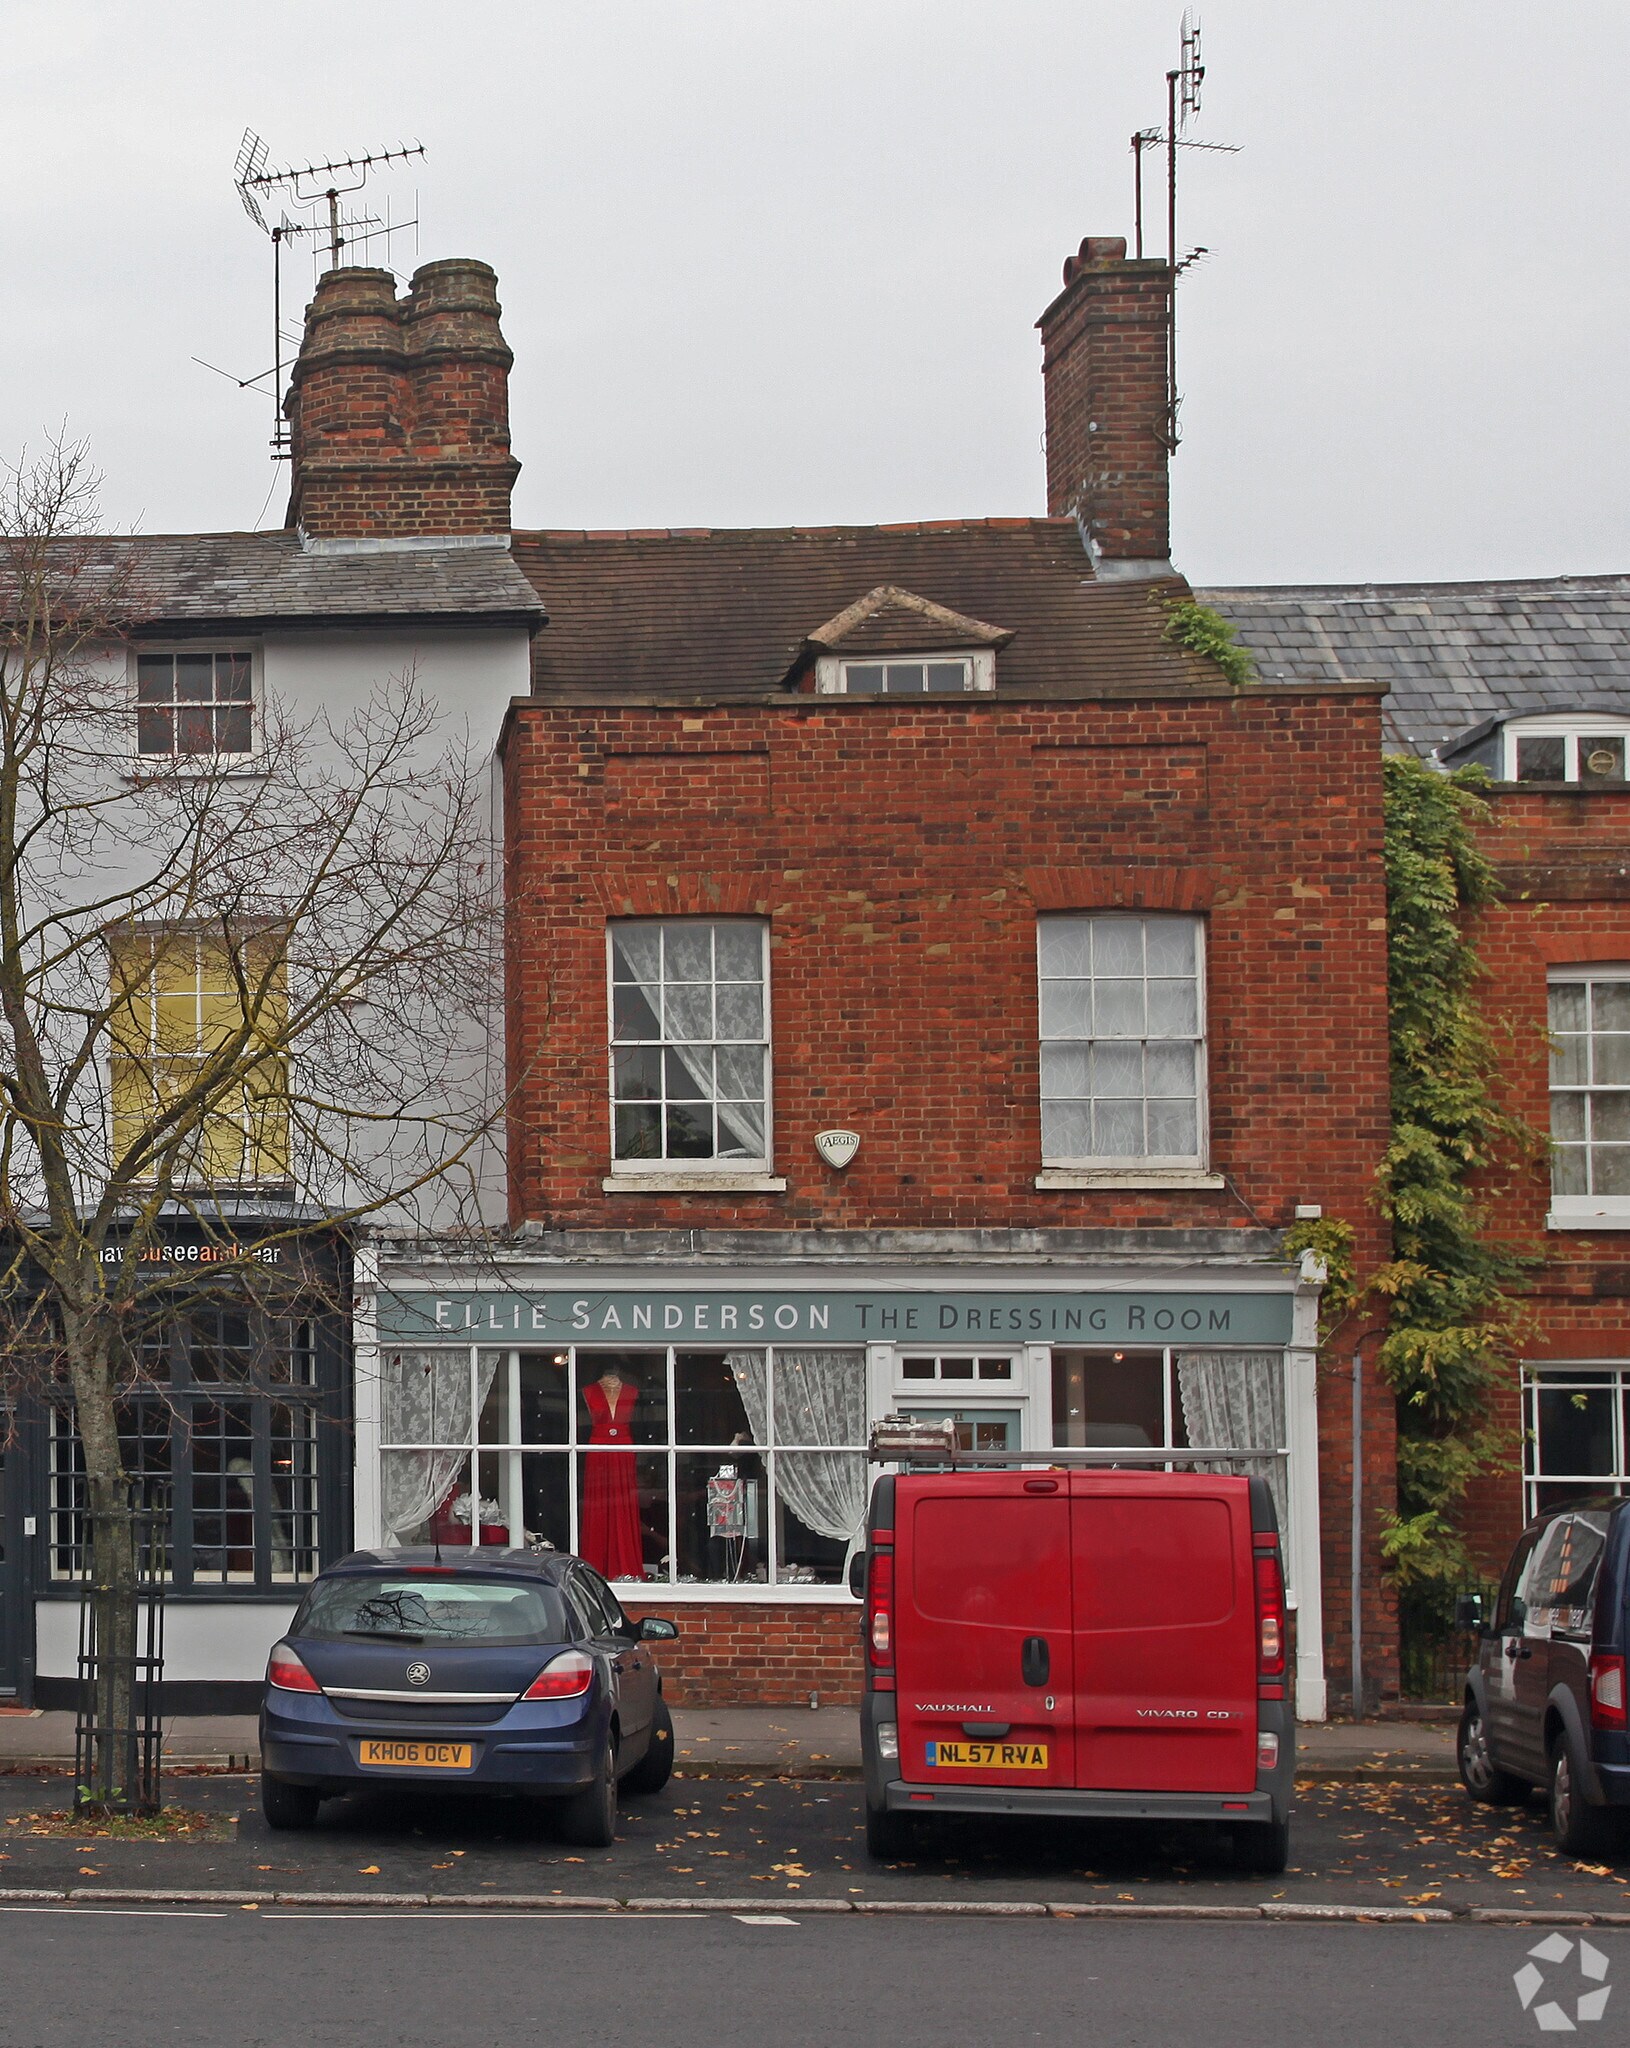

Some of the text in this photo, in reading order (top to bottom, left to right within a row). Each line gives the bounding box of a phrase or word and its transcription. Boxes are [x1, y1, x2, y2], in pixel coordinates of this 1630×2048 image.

[823, 1136, 856, 1147] AEGIS
[435, 1300, 1231, 1331] ELLIE SANDERSON THE DRESSING ROOM
[914, 1703, 996, 1713] VAUXHALL
[1136, 1709, 1199, 1718] VIVARO
[369, 1742, 463, 1763] KH06 OCV
[940, 1744, 1044, 1765] NL57 RVA
